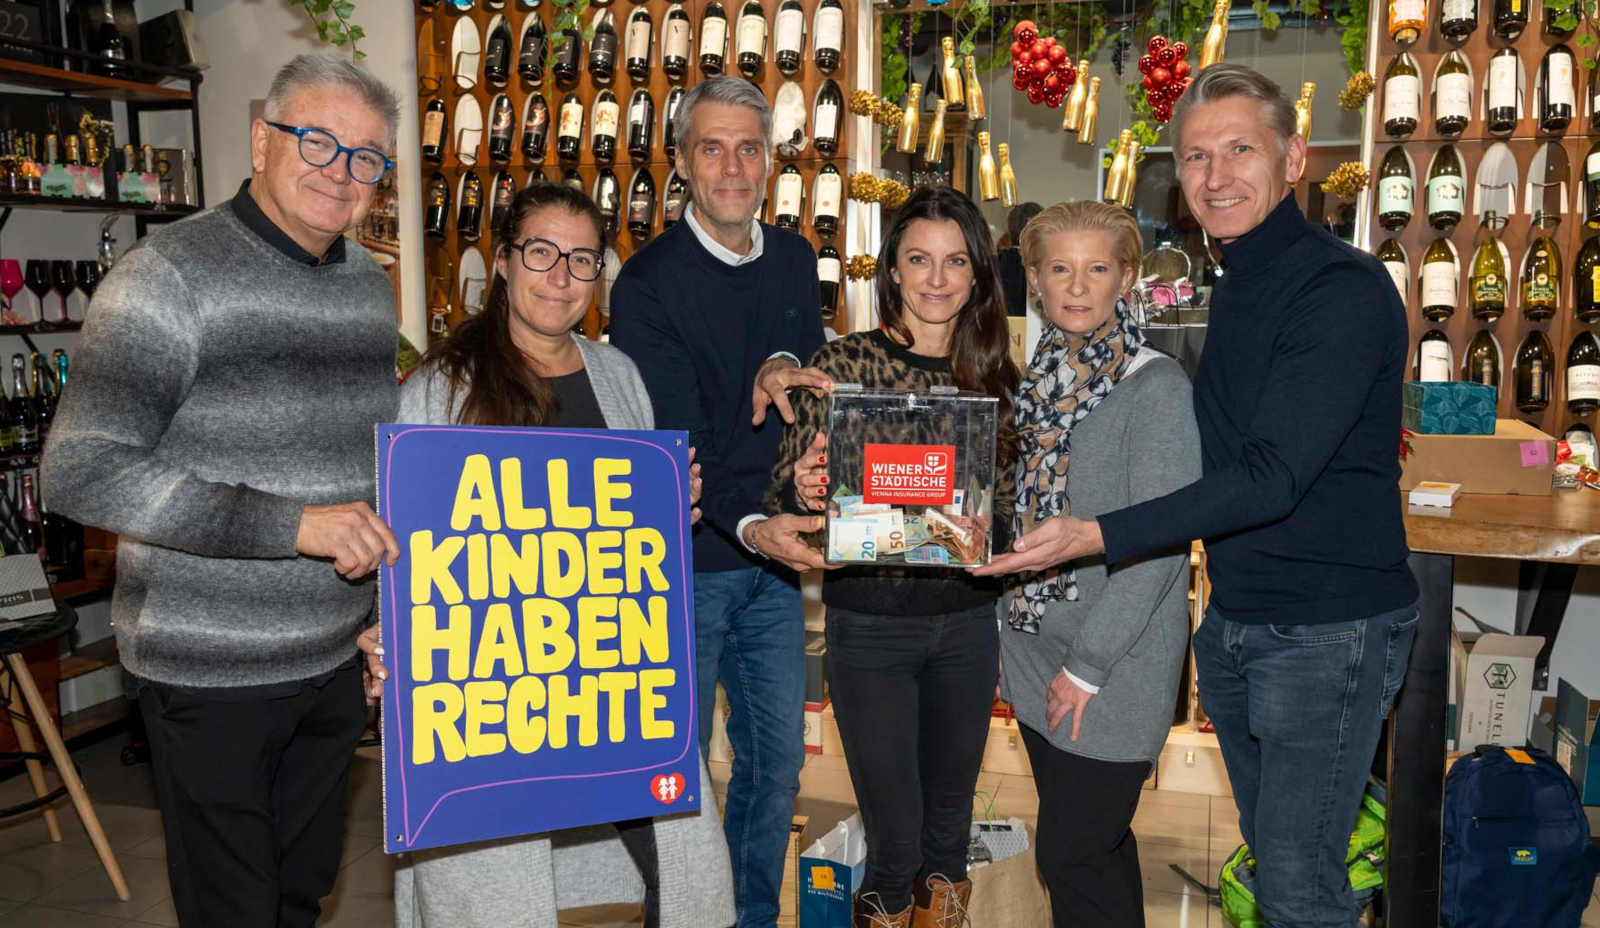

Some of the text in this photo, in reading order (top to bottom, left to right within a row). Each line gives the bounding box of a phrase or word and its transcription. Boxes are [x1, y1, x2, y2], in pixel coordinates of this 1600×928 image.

[450, 453, 634, 531] ALLE
[871, 463, 923, 475] WIENER
[871, 475, 947, 488] STÄDTISCHE
[861, 541, 875, 559] 20
[889, 530, 904, 549] 50
[409, 527, 670, 605] KINDER
[411, 596, 670, 682] HABEN
[412, 668, 676, 765] RECHTE
